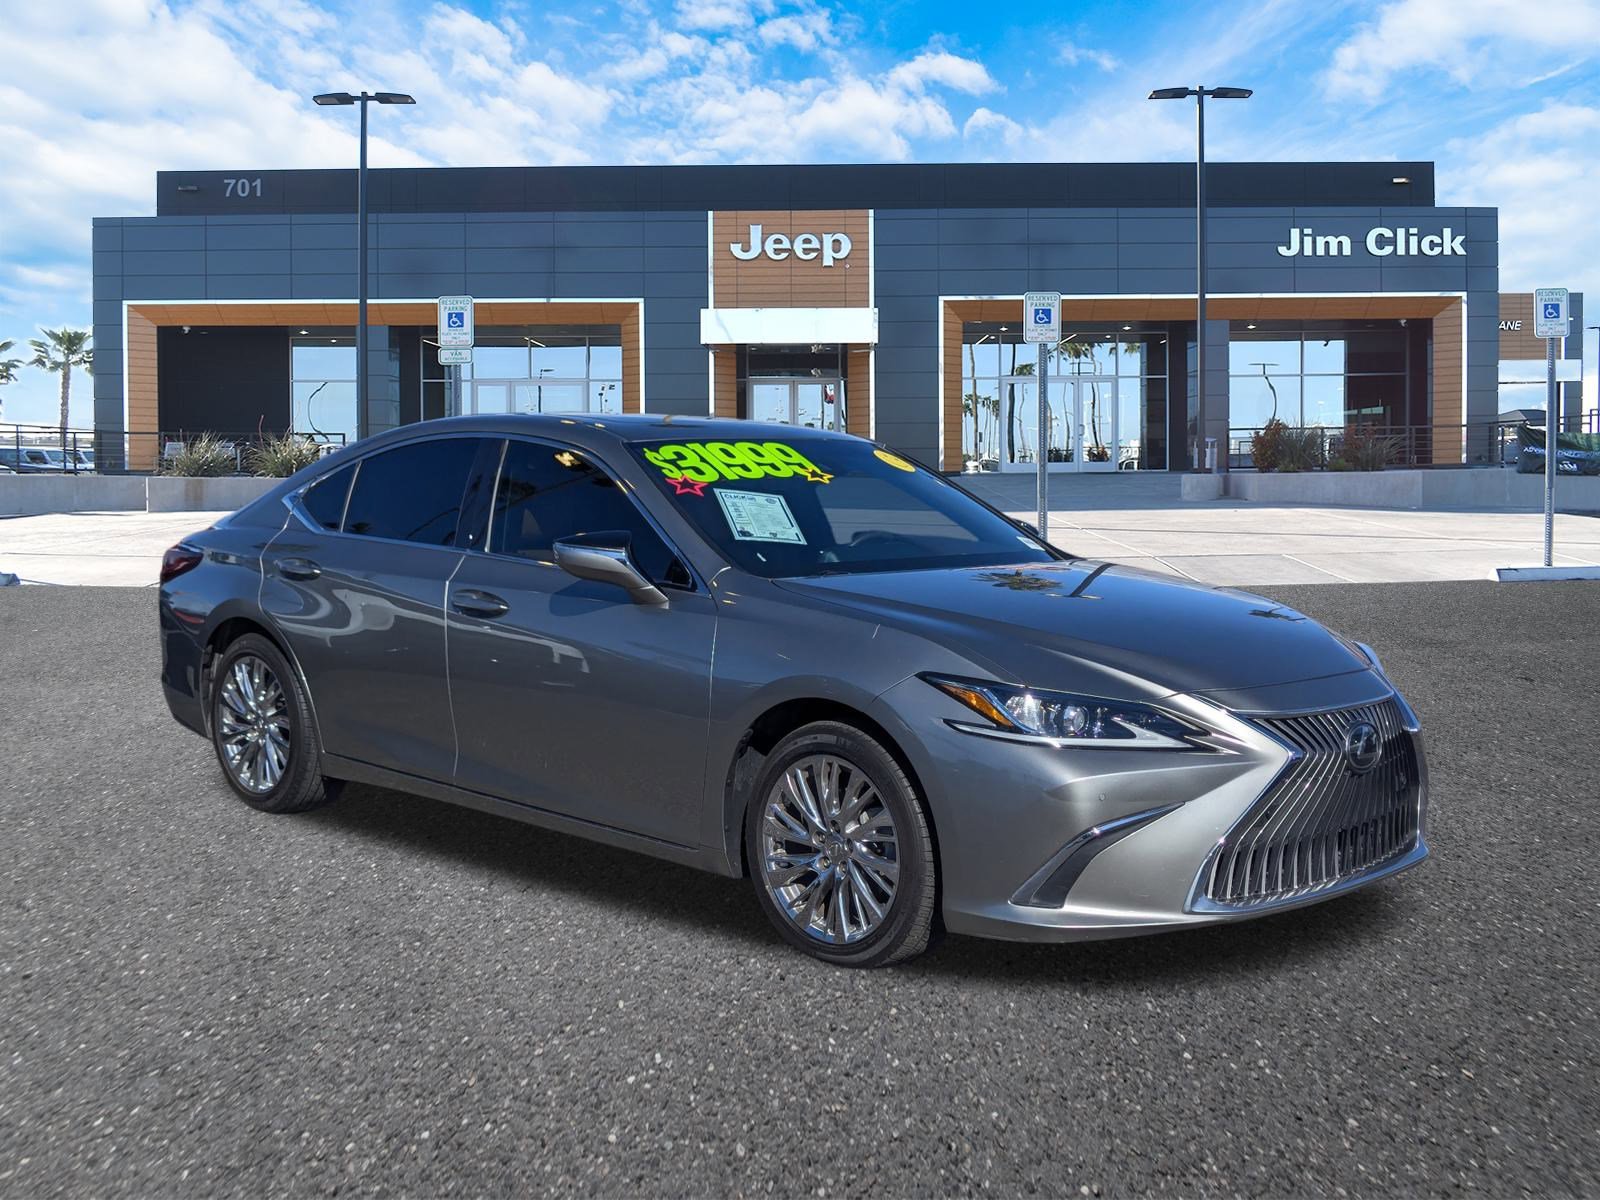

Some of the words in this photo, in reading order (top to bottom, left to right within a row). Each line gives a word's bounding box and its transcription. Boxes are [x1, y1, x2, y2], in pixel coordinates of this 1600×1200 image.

[224, 178, 261, 197] 701
[730, 224, 852, 268] Jeep
[1277, 228, 1351, 256] Jim
[1366, 227, 1467, 256] Click
